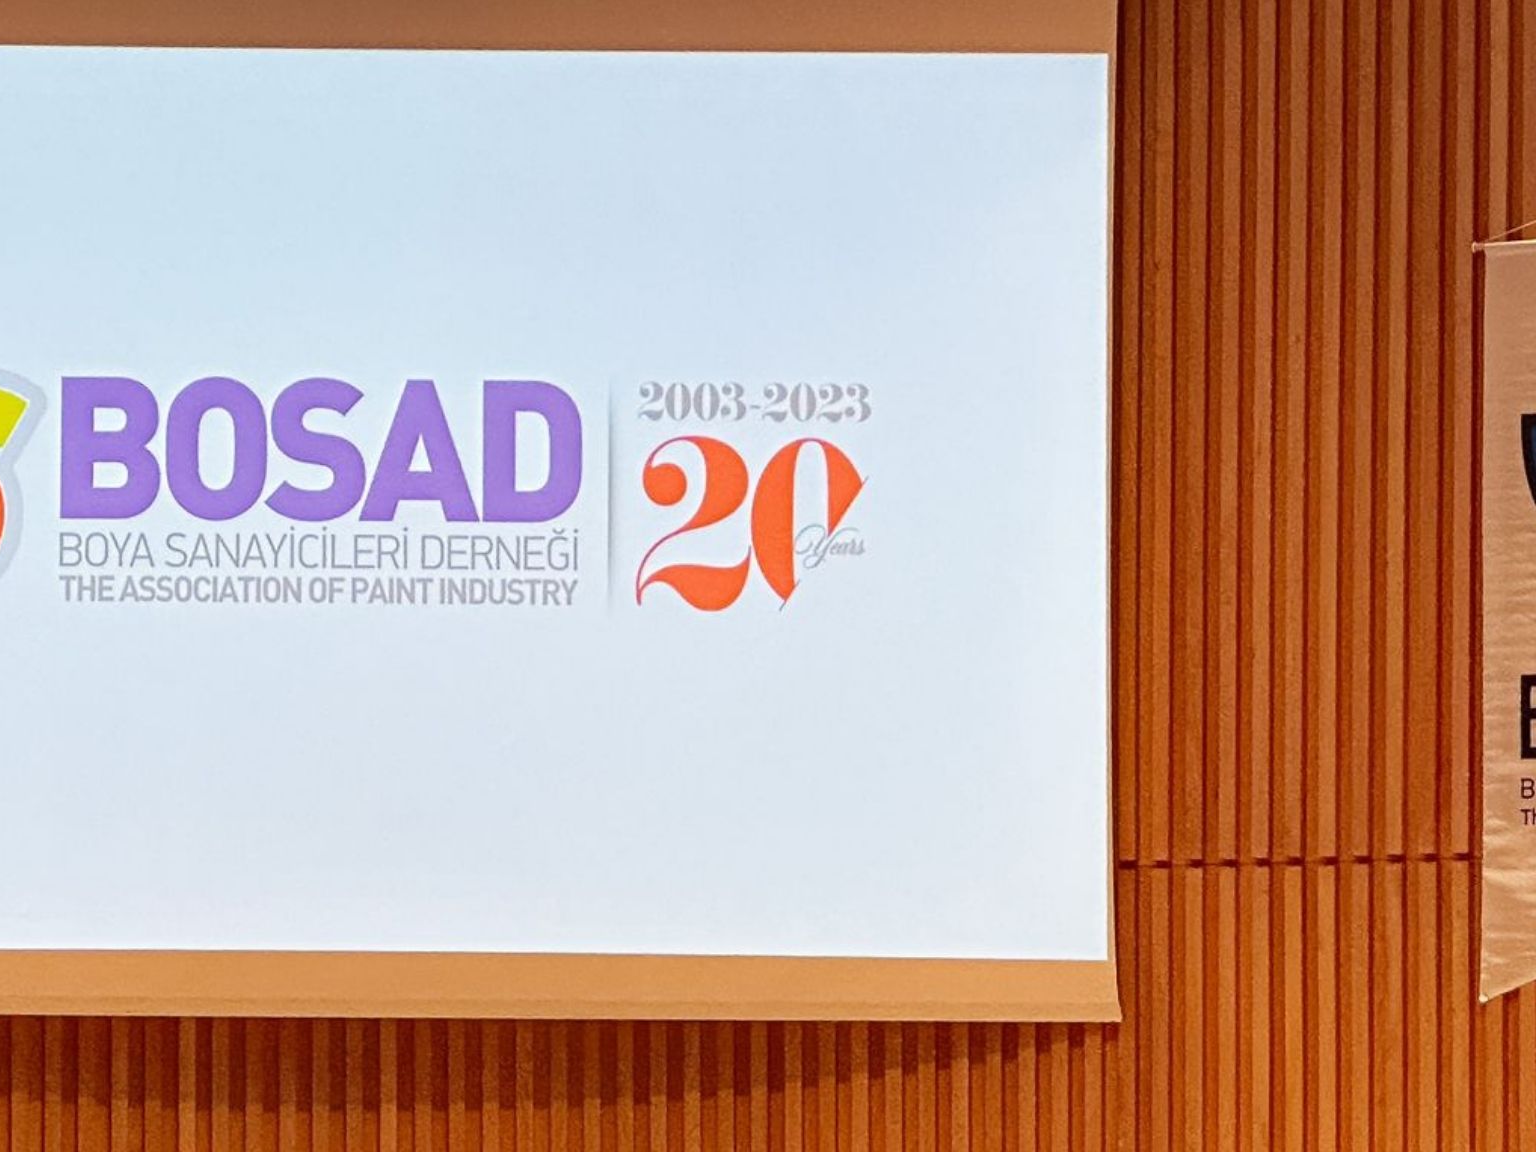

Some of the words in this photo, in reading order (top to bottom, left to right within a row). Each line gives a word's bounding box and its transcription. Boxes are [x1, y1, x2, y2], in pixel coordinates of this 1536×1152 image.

[638, 381, 872, 423] 2003-2023
[60, 376, 582, 523] BOSAD
[636, 436, 868, 612] 20
[794, 523, 866, 570] Years
[59, 532, 155, 567] BOYA
[165, 526, 409, 570] SANAYİCİLERİ
[421, 528, 579, 571] DERNEĞİ
[59, 575, 115, 602] THE
[120, 575, 302, 603] ASSOCIATION
[308, 576, 345, 603] OF
[351, 577, 434, 604] PAINT
[439, 578, 578, 606] INDUSTRY
